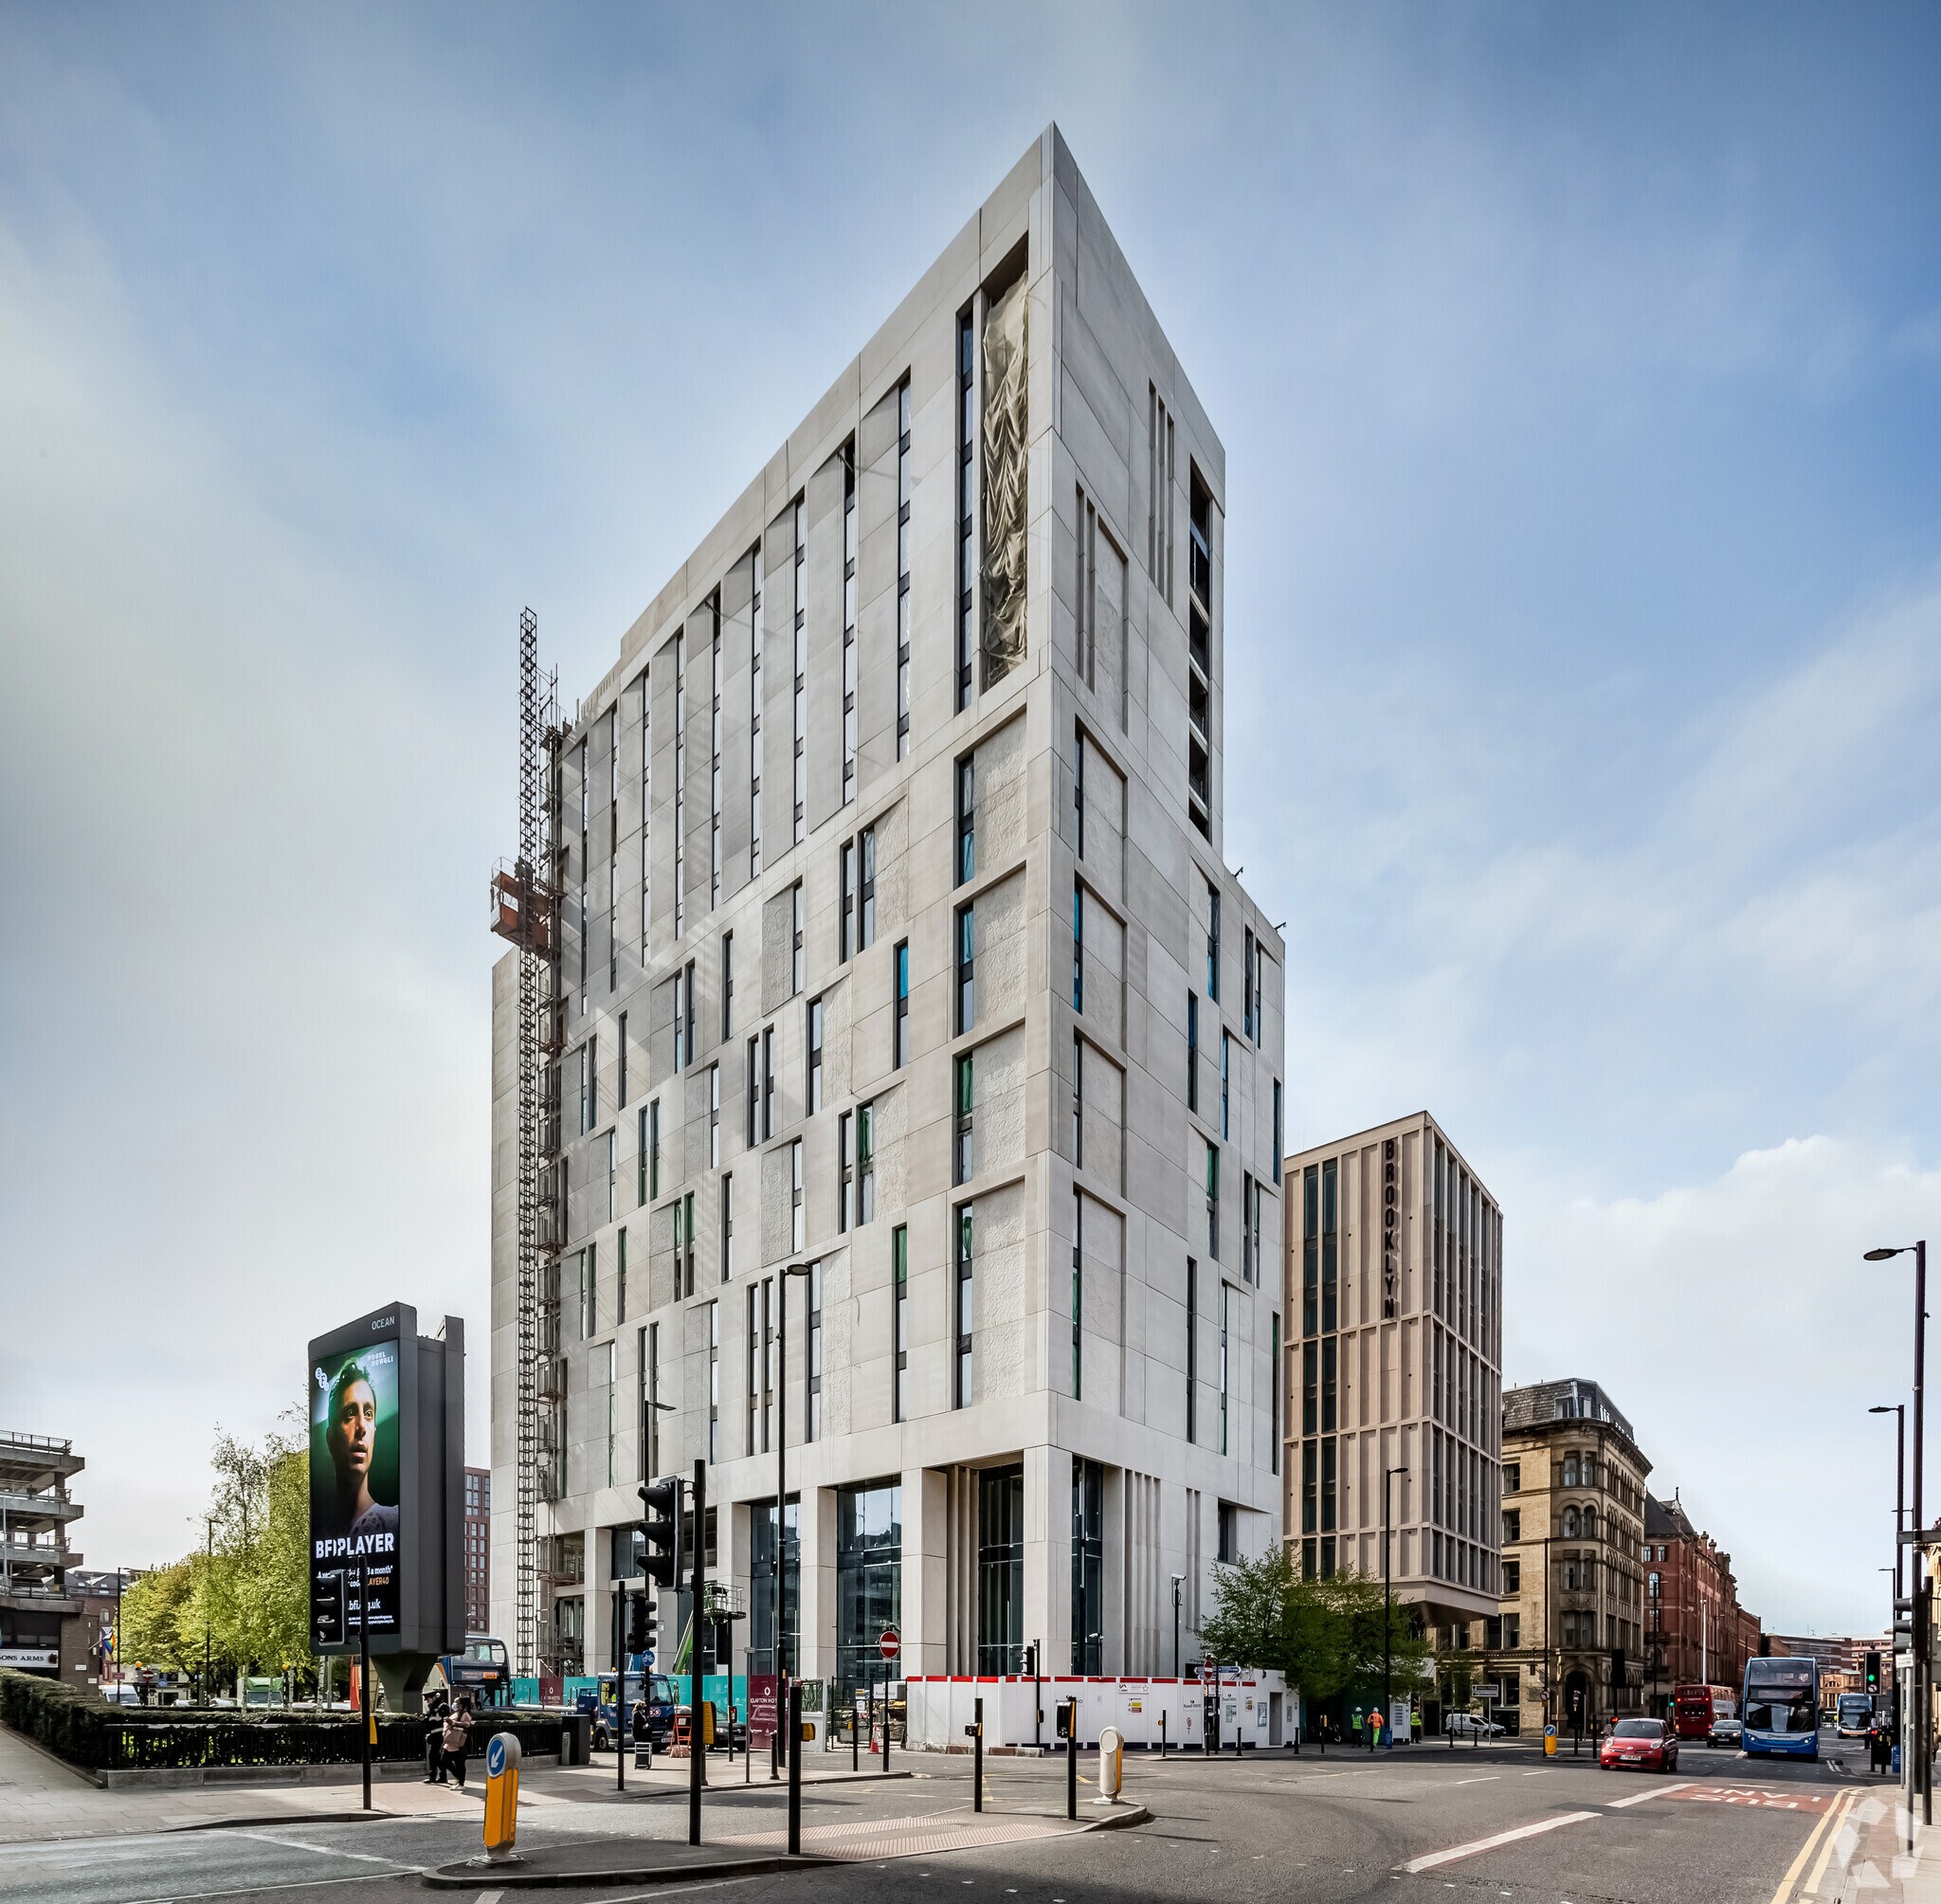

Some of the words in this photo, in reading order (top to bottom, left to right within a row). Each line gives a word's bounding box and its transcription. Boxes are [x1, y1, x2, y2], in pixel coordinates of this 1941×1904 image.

[1385, 1138, 1395, 1319] BROOKLYN
[372, 1315, 395, 1331] OCEAN
[1689, 1794, 1799, 1808] BUS
[1693, 1786, 1822, 1803] LANE
